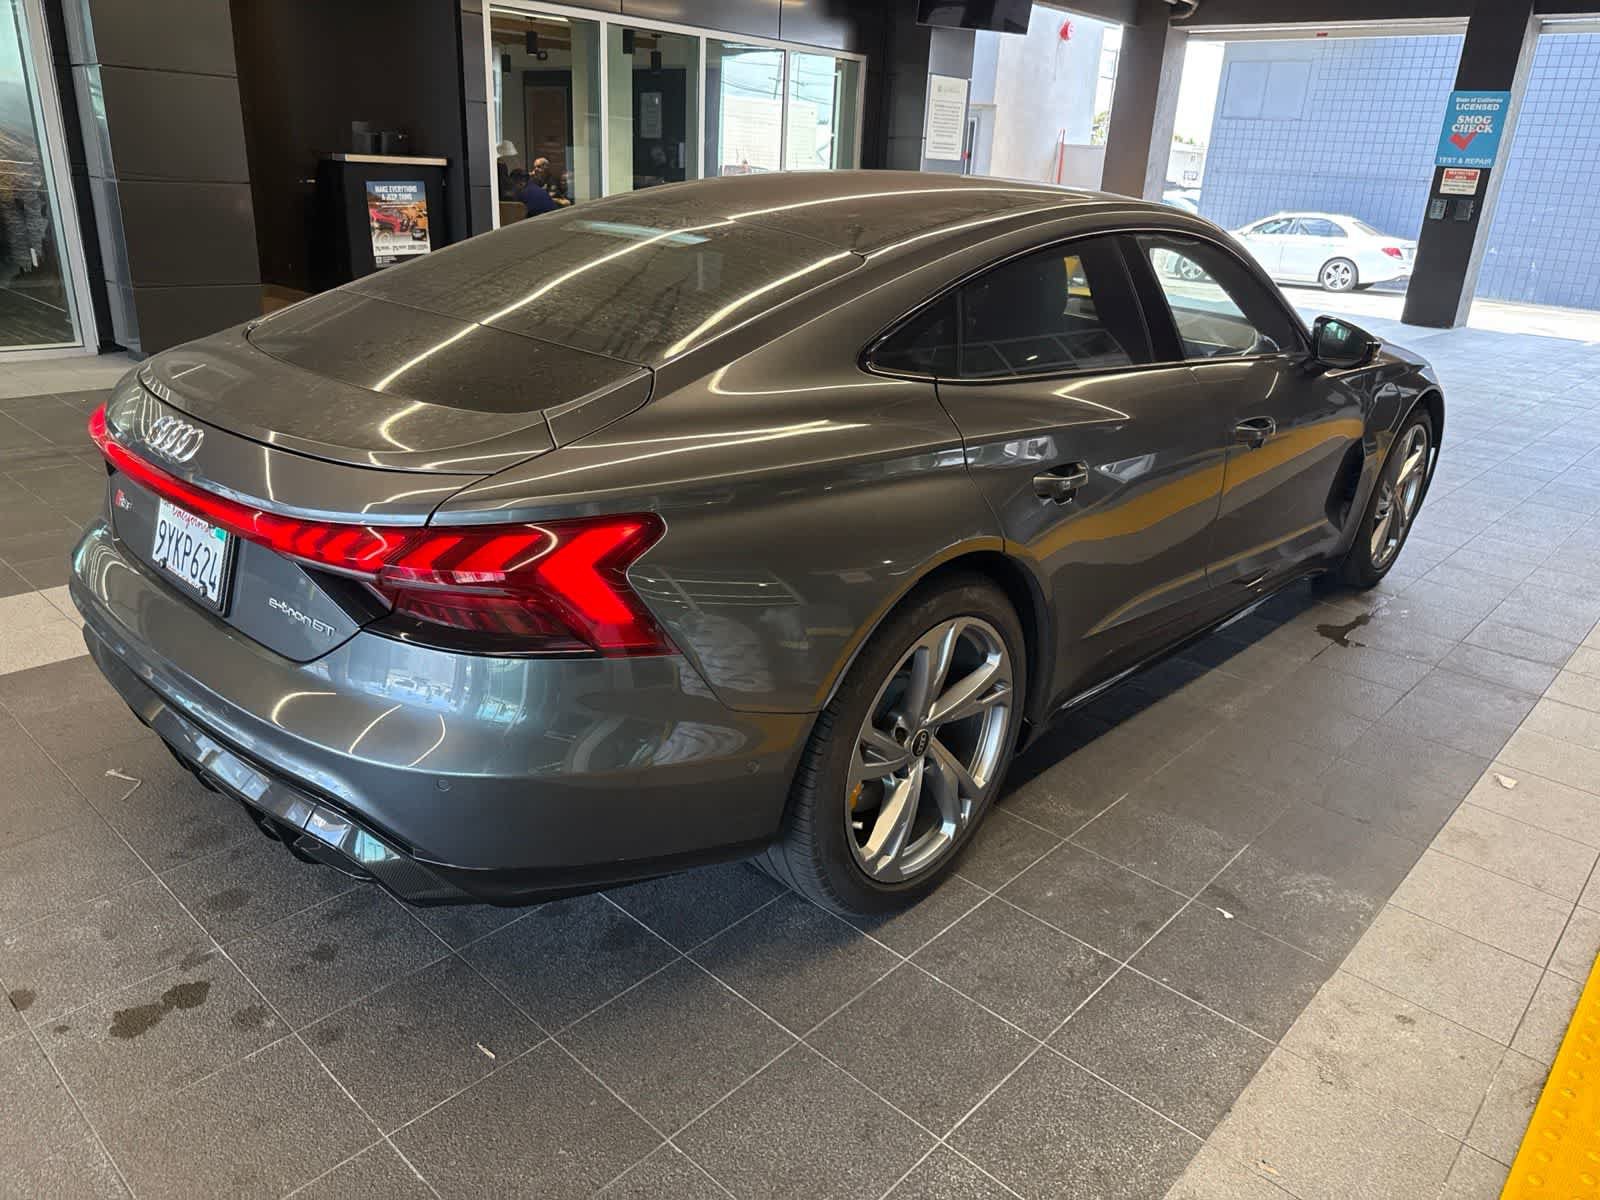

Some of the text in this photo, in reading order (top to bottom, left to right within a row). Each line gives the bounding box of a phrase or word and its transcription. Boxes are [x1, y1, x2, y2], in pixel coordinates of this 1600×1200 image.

[1456, 103, 1500, 111] LICENSED
[1456, 114, 1492, 124] SMOG
[1452, 124, 1493, 134] CHECK
[1464, 157, 1492, 165] REPAIR
[156, 520, 218, 593] 9YKP624
[268, 597, 336, 636] e-tron GT
